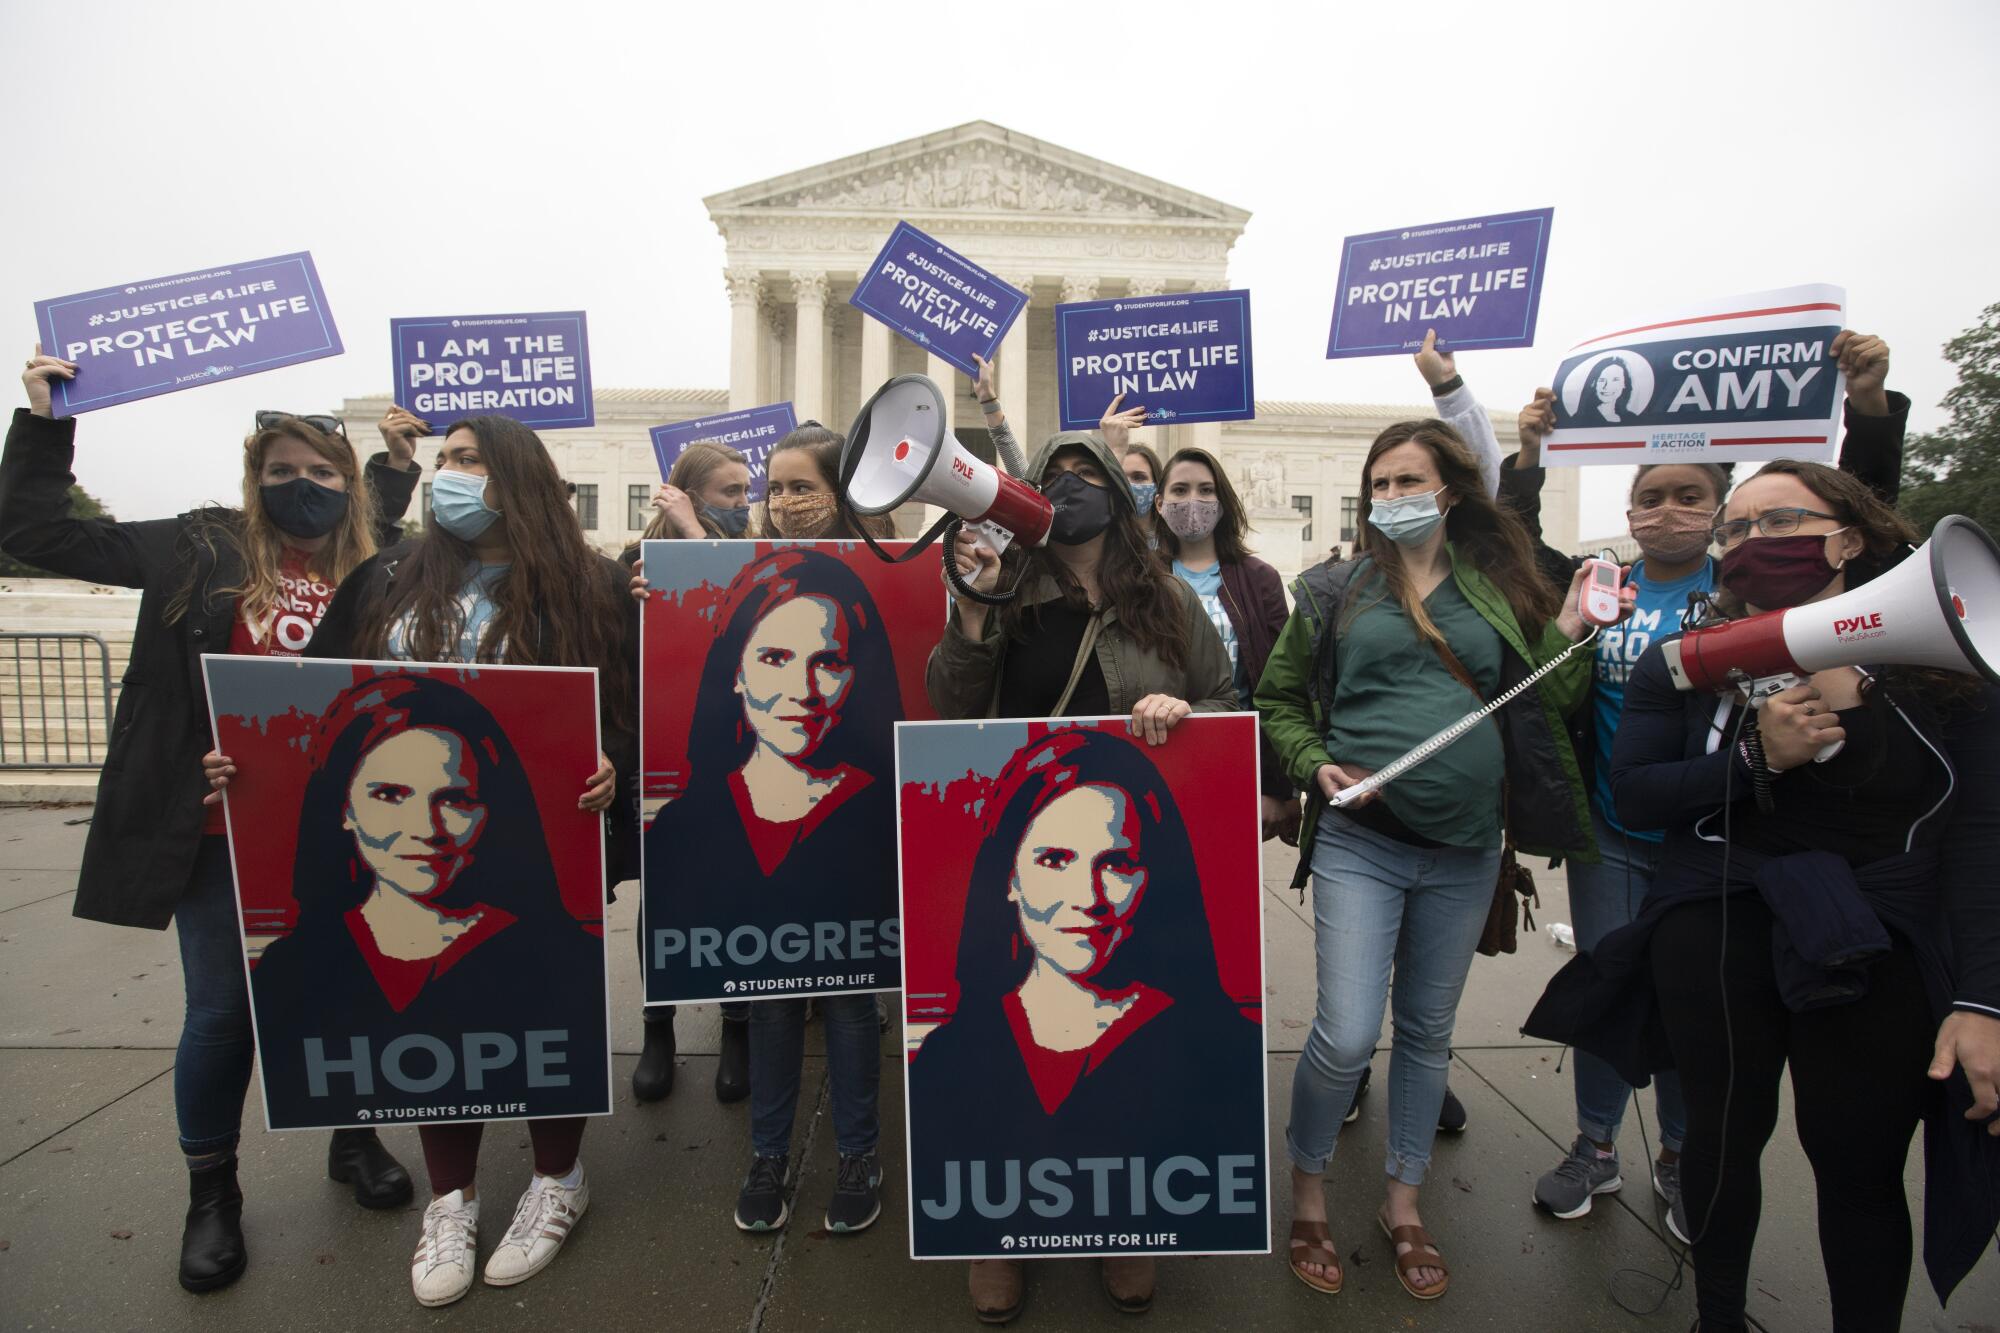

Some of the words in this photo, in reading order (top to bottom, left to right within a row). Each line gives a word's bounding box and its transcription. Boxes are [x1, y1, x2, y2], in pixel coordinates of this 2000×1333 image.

[1411, 222, 1482, 238] STUDENTSFORLIFE.ORG
[1369, 241, 1511, 271] #JUSTICE4LIFE
[138, 270, 232, 291] STUDENTSFORLIFE.ORG
[906, 252, 997, 310] #JUSTICE4LIFE
[1348, 274, 1463, 306] PROTECT
[1469, 267, 1528, 293] LIFE
[88, 280, 277, 327] #JUSTICE4LIFE
[881, 261, 961, 315] PROTECT
[959, 308, 998, 338] LIFE
[1123, 299, 1190, 310] STUDENTSFORLIFE.ORG
[1384, 301, 1413, 324] IN
[1419, 296, 1477, 321] LAW
[66, 311, 231, 361] PROTECT
[240, 295, 310, 324] LIFE
[461, 318, 528, 327] STUDENTSFORLIFE.ORG
[899, 292, 923, 313] IN
[922, 306, 962, 336] LAW
[1087, 320, 1219, 342] #JUSTICE4LIFE
[133, 343, 174, 367] IN
[185, 324, 257, 356] LAW
[417, 340, 425, 358] I
[441, 338, 490, 358] AM
[504, 335, 564, 354] THE
[1672, 340, 1824, 372] CONFIRM
[410, 356, 576, 388] PRO-LIFE
[1072, 348, 1181, 376] PROTECT
[1188, 344, 1239, 368] LIFE
[1113, 374, 1139, 395] IN
[1147, 369, 1198, 393] LAW
[1666, 366, 1823, 413] AMY
[415, 386, 574, 413] GENERATION
[1652, 432, 1706, 440] HERITAGE
[1661, 440, 1705, 448] ACTION
[953, 456, 974, 480] PYLE
[1833, 612, 1883, 635] PYLE
[654, 917, 901, 970] PROGRES
[739, 976, 813, 992] STUDENTS
[817, 975, 844, 987] FOR
[848, 973, 876, 985] LIFE
[303, 1029, 571, 1098] HOPE
[374, 1105, 457, 1120] STUDENTS
[461, 1103, 493, 1116] FOR
[497, 1102, 527, 1114] LIFE
[920, 1154, 1257, 1220] JUSTICE
[1018, 1234, 1104, 1249] STUDENTS
[1108, 1233, 1141, 1246] FOR
[1145, 1232, 1177, 1245] LIFE
